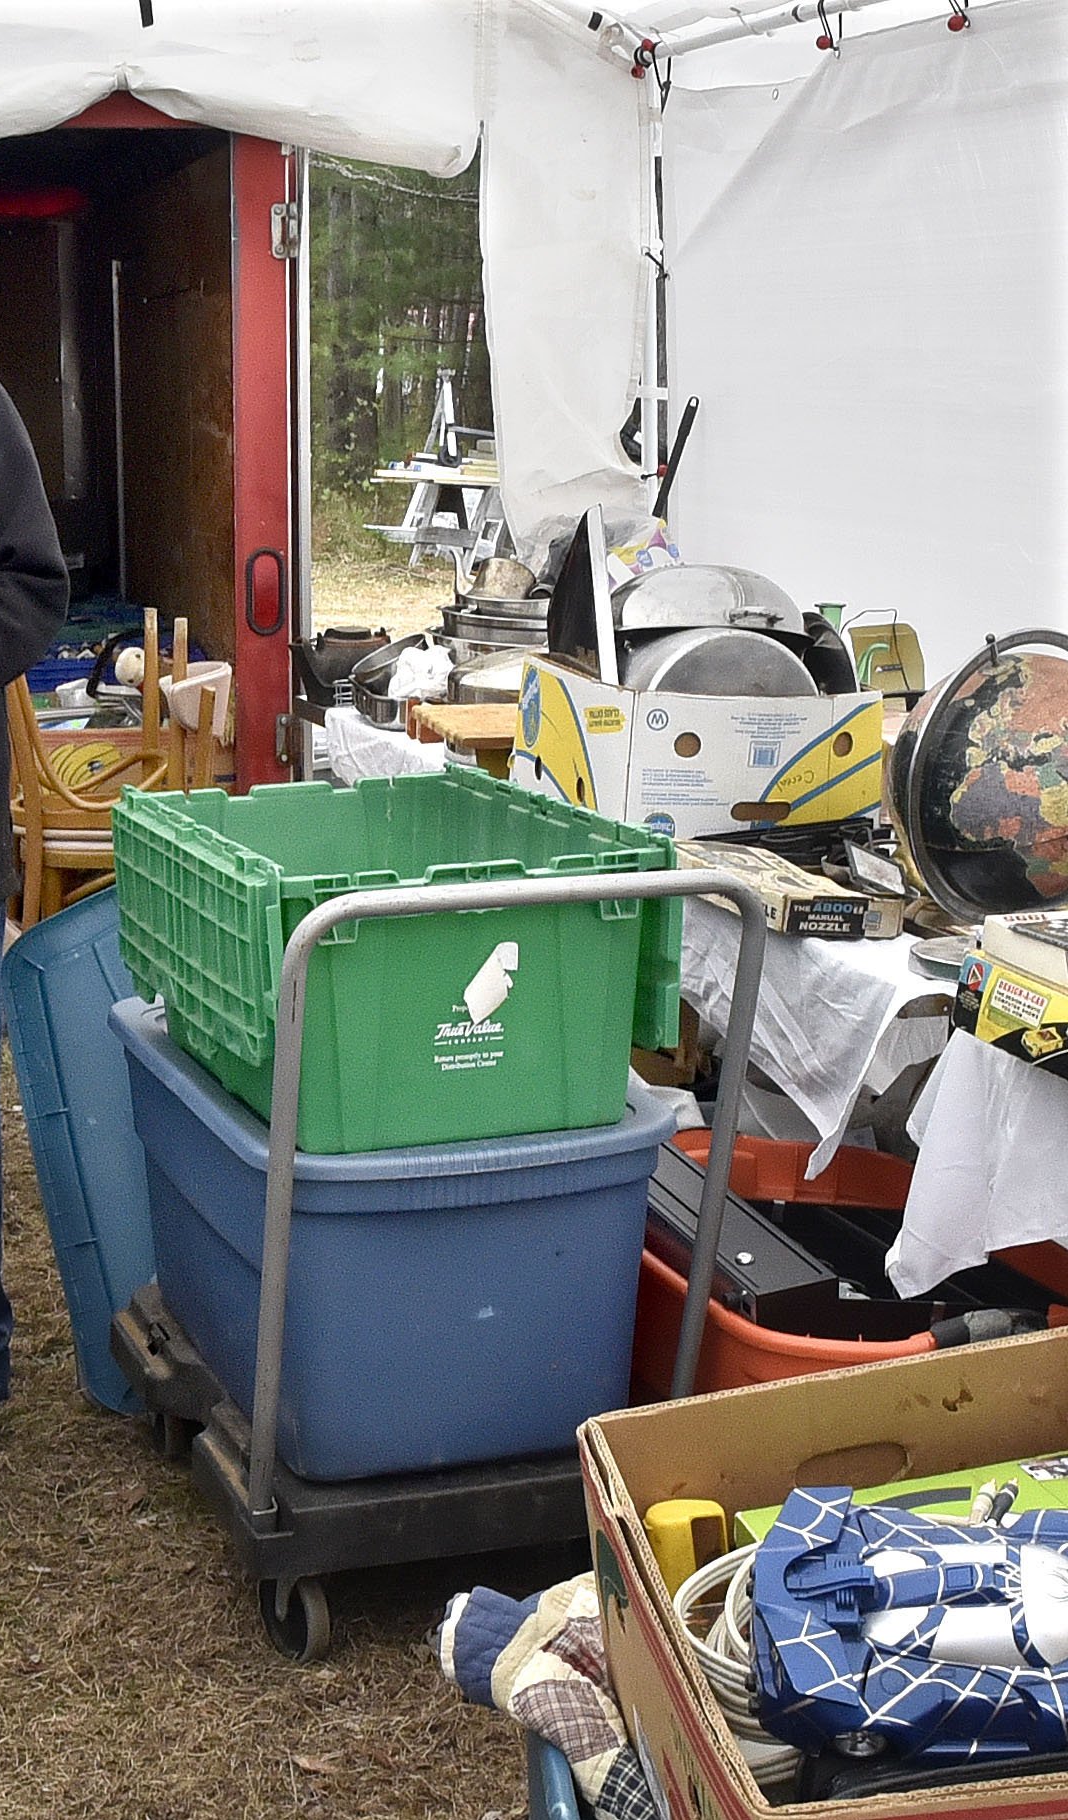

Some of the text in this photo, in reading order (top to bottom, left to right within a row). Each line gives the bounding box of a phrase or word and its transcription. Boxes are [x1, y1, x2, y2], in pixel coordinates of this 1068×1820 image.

[776, 770, 815, 793] Cereal
[794, 905, 811, 913] THE
[807, 914, 844, 922] MANUAL
[799, 922, 851, 932] NOZZLE
